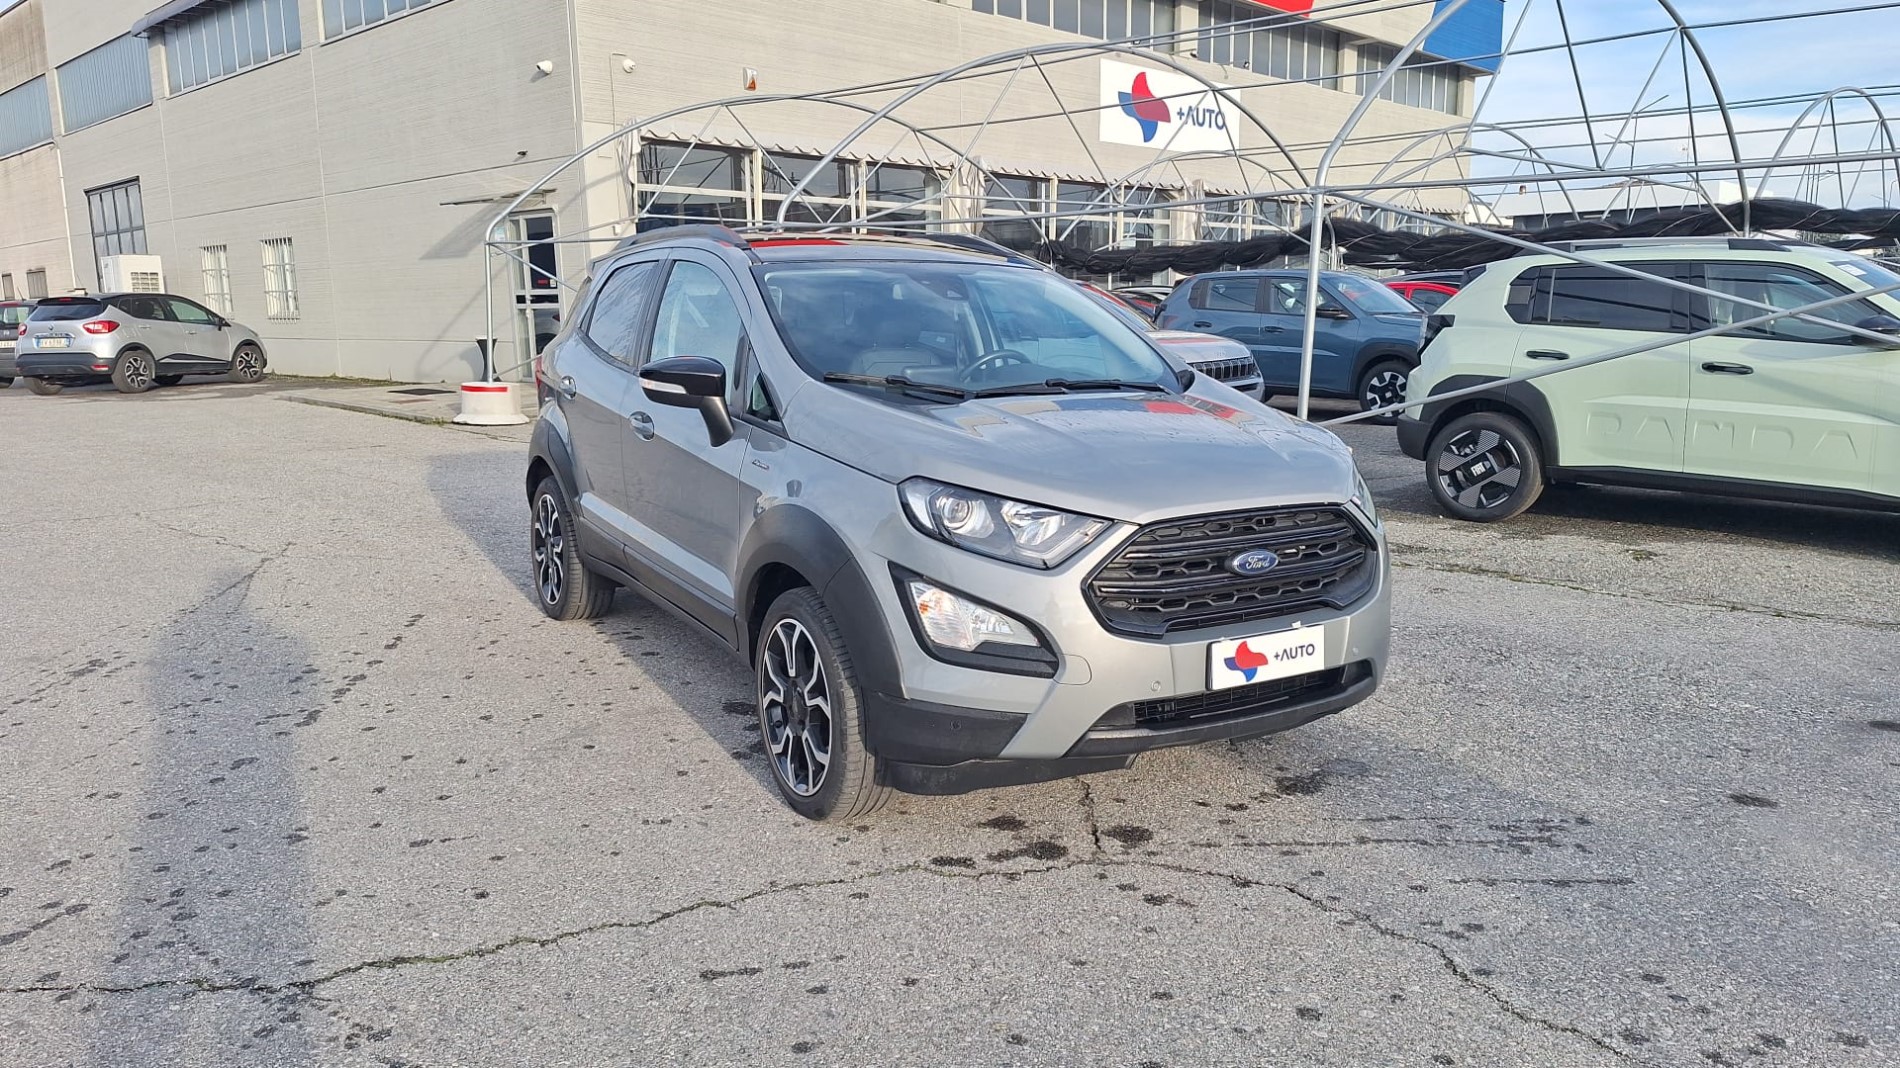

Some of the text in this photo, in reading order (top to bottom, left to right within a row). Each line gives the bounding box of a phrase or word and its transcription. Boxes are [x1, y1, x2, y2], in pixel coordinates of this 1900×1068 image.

[1176, 105, 1226, 131] +AUTO
[1245, 555, 1271, 570] Ford
[1273, 643, 1316, 662] +AUTO
